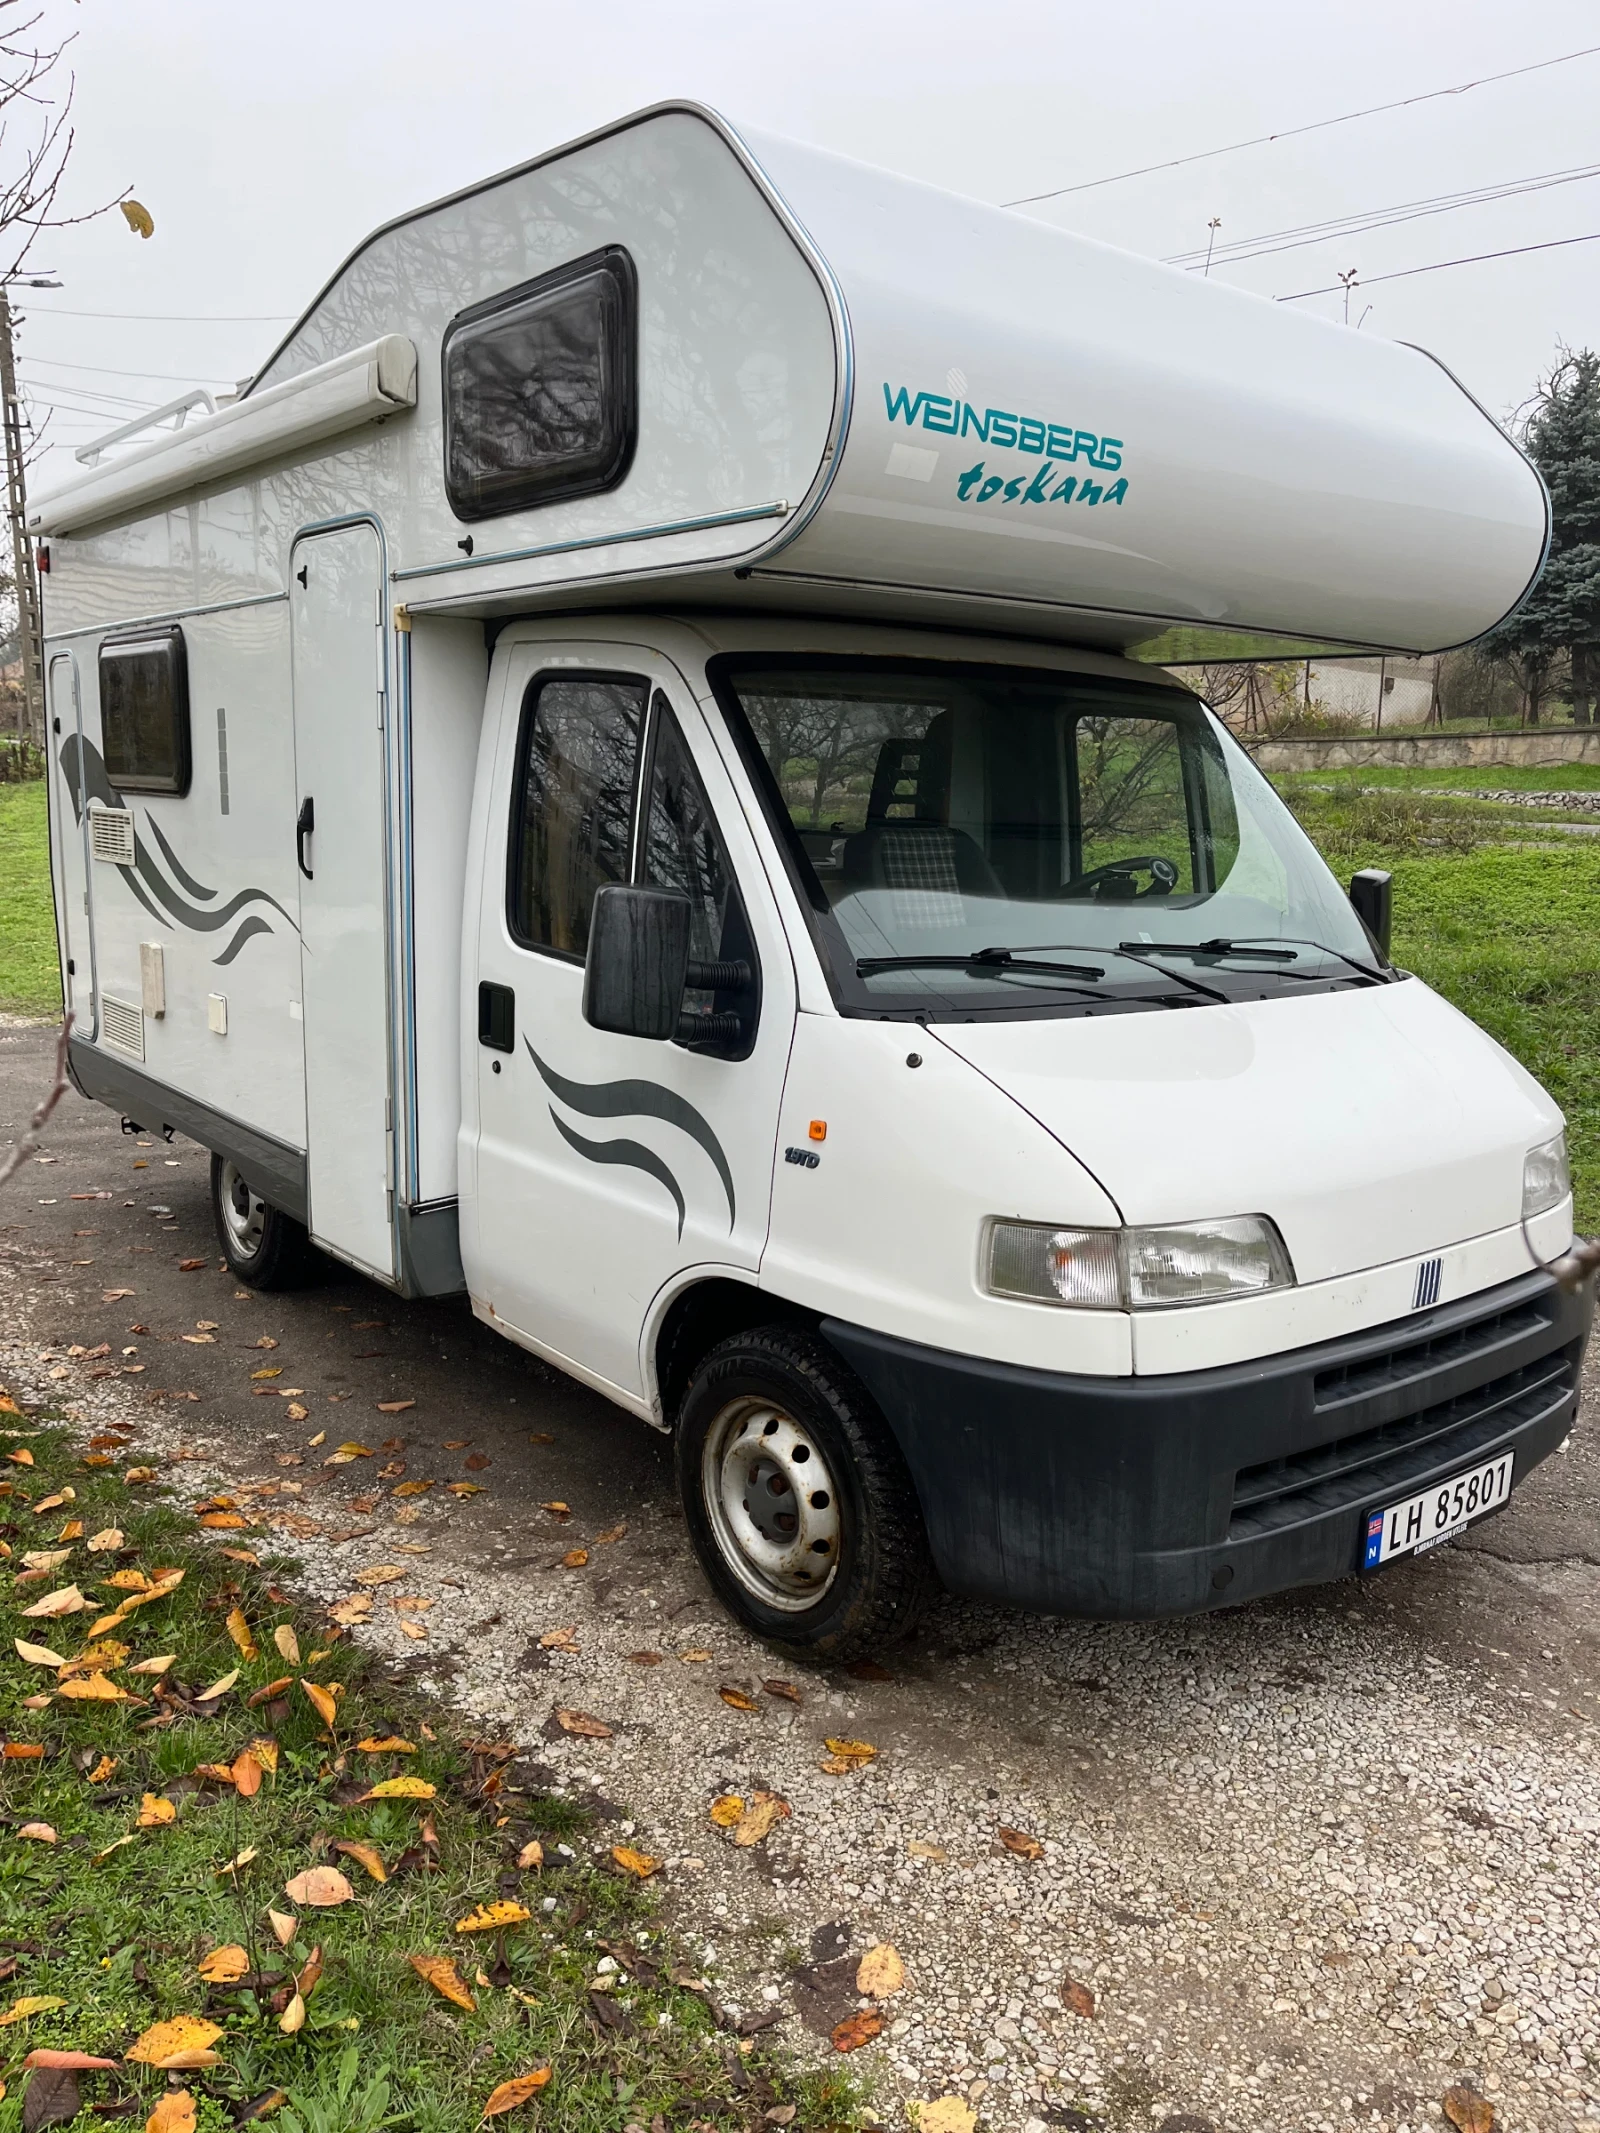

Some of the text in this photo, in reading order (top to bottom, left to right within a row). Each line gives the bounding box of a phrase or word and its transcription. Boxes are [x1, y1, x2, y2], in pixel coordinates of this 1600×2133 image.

[883, 382, 1124, 471] WEINSBERG
[957, 461, 1129, 506] toskana
[1389, 1461, 1506, 1551] LH 85801
[1368, 1546, 1377, 1559] N
